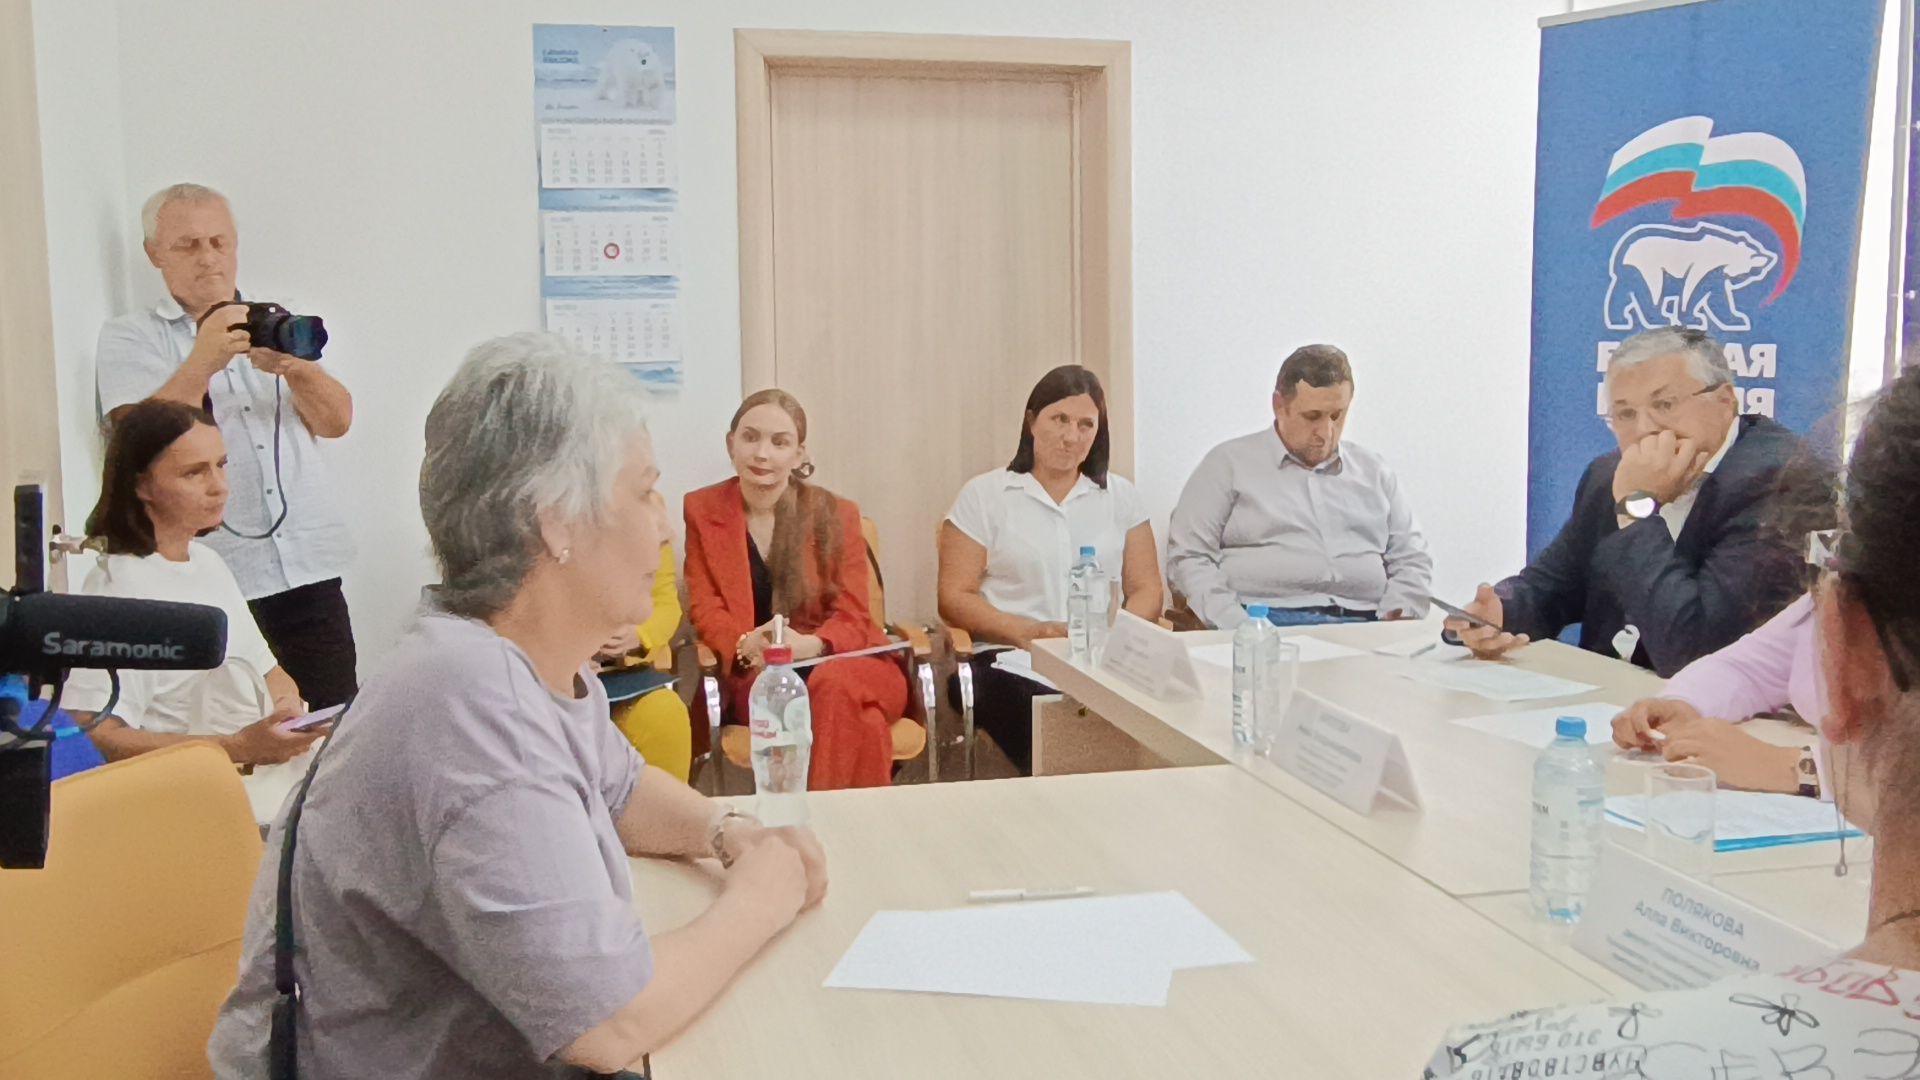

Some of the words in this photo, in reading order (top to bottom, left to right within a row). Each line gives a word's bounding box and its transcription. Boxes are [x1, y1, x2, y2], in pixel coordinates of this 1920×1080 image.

[43, 631, 184, 661] Saramonic
[1635, 899, 1668, 927] Алла
[1670, 918, 1760, 971] Викторовна
[1661, 887, 1744, 938] ПОЛЯКОВА
